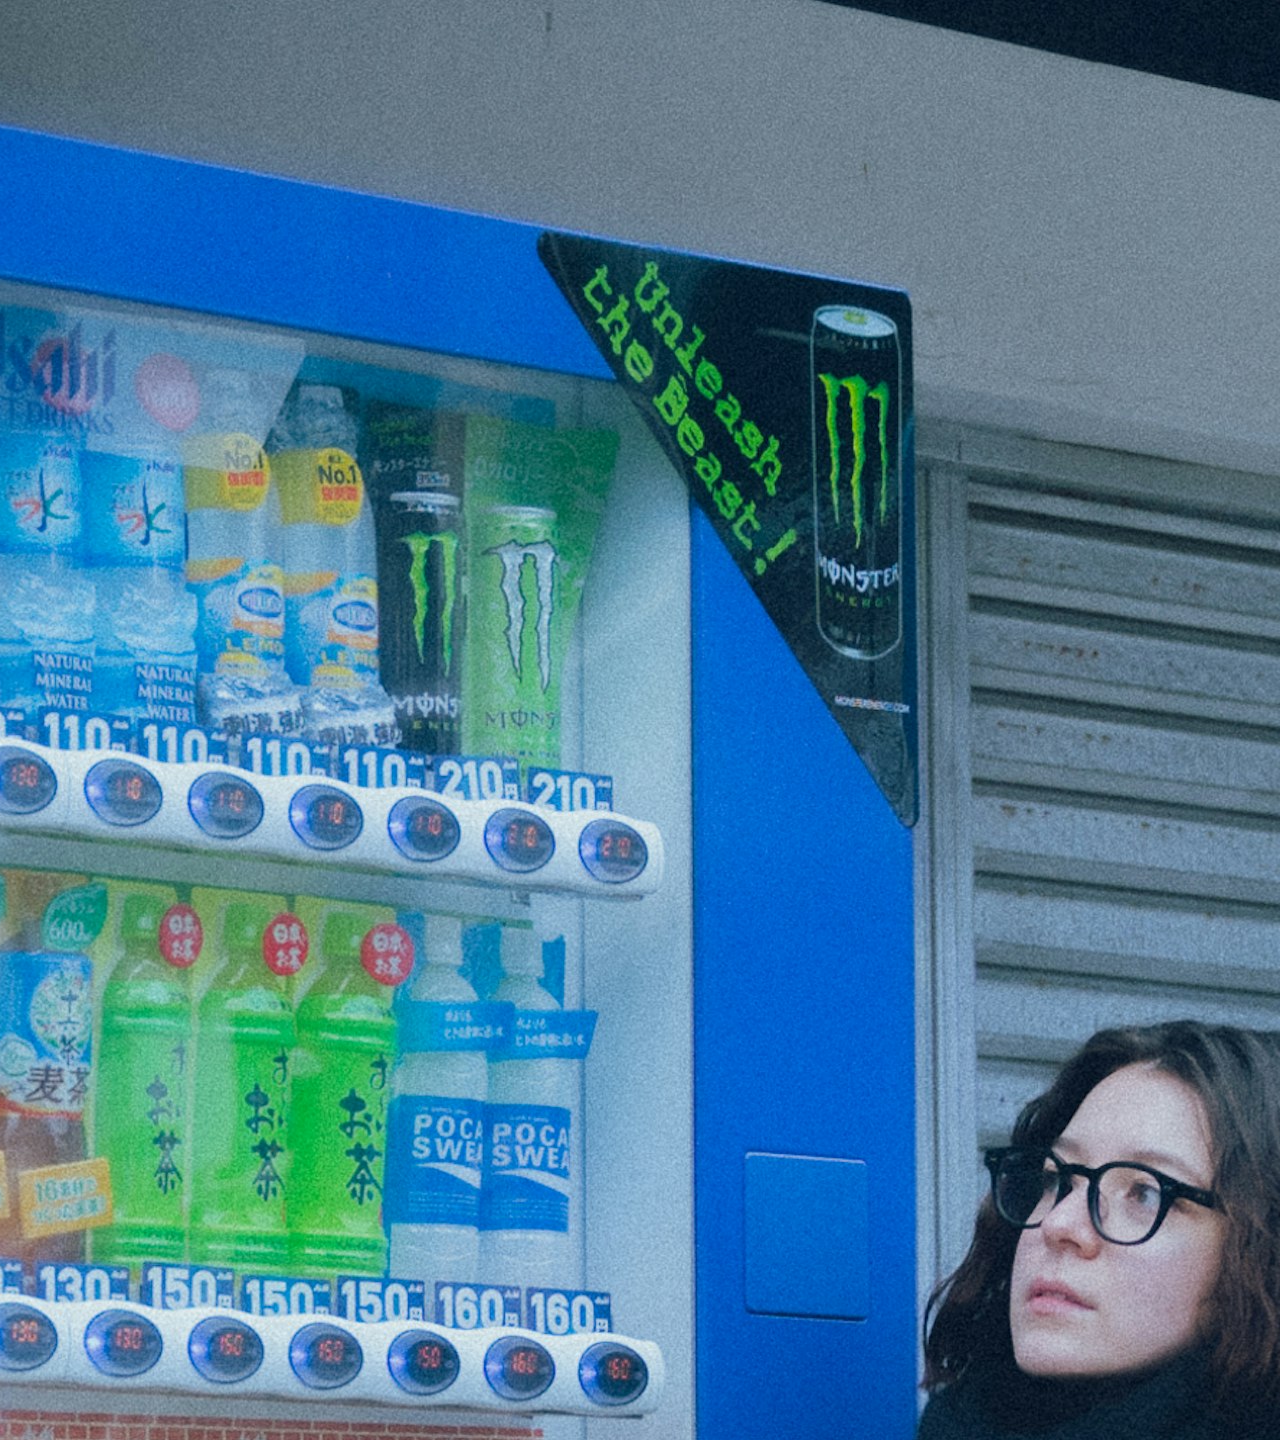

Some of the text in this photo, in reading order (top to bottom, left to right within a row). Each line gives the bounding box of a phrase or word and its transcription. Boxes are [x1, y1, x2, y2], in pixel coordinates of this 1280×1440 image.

[318, 464, 357, 484] No.1
[817, 554, 900, 594] MONSTER
[33, 652, 93, 673] NATURAL
[36, 672, 93, 693] MINERAL
[136, 663, 195, 686] NATURAL
[46, 692, 89, 711] WATER
[138, 683, 195, 704] MINERAL
[147, 703, 191, 723] WATER
[25, 1063, 89, 1105] 麦茶
